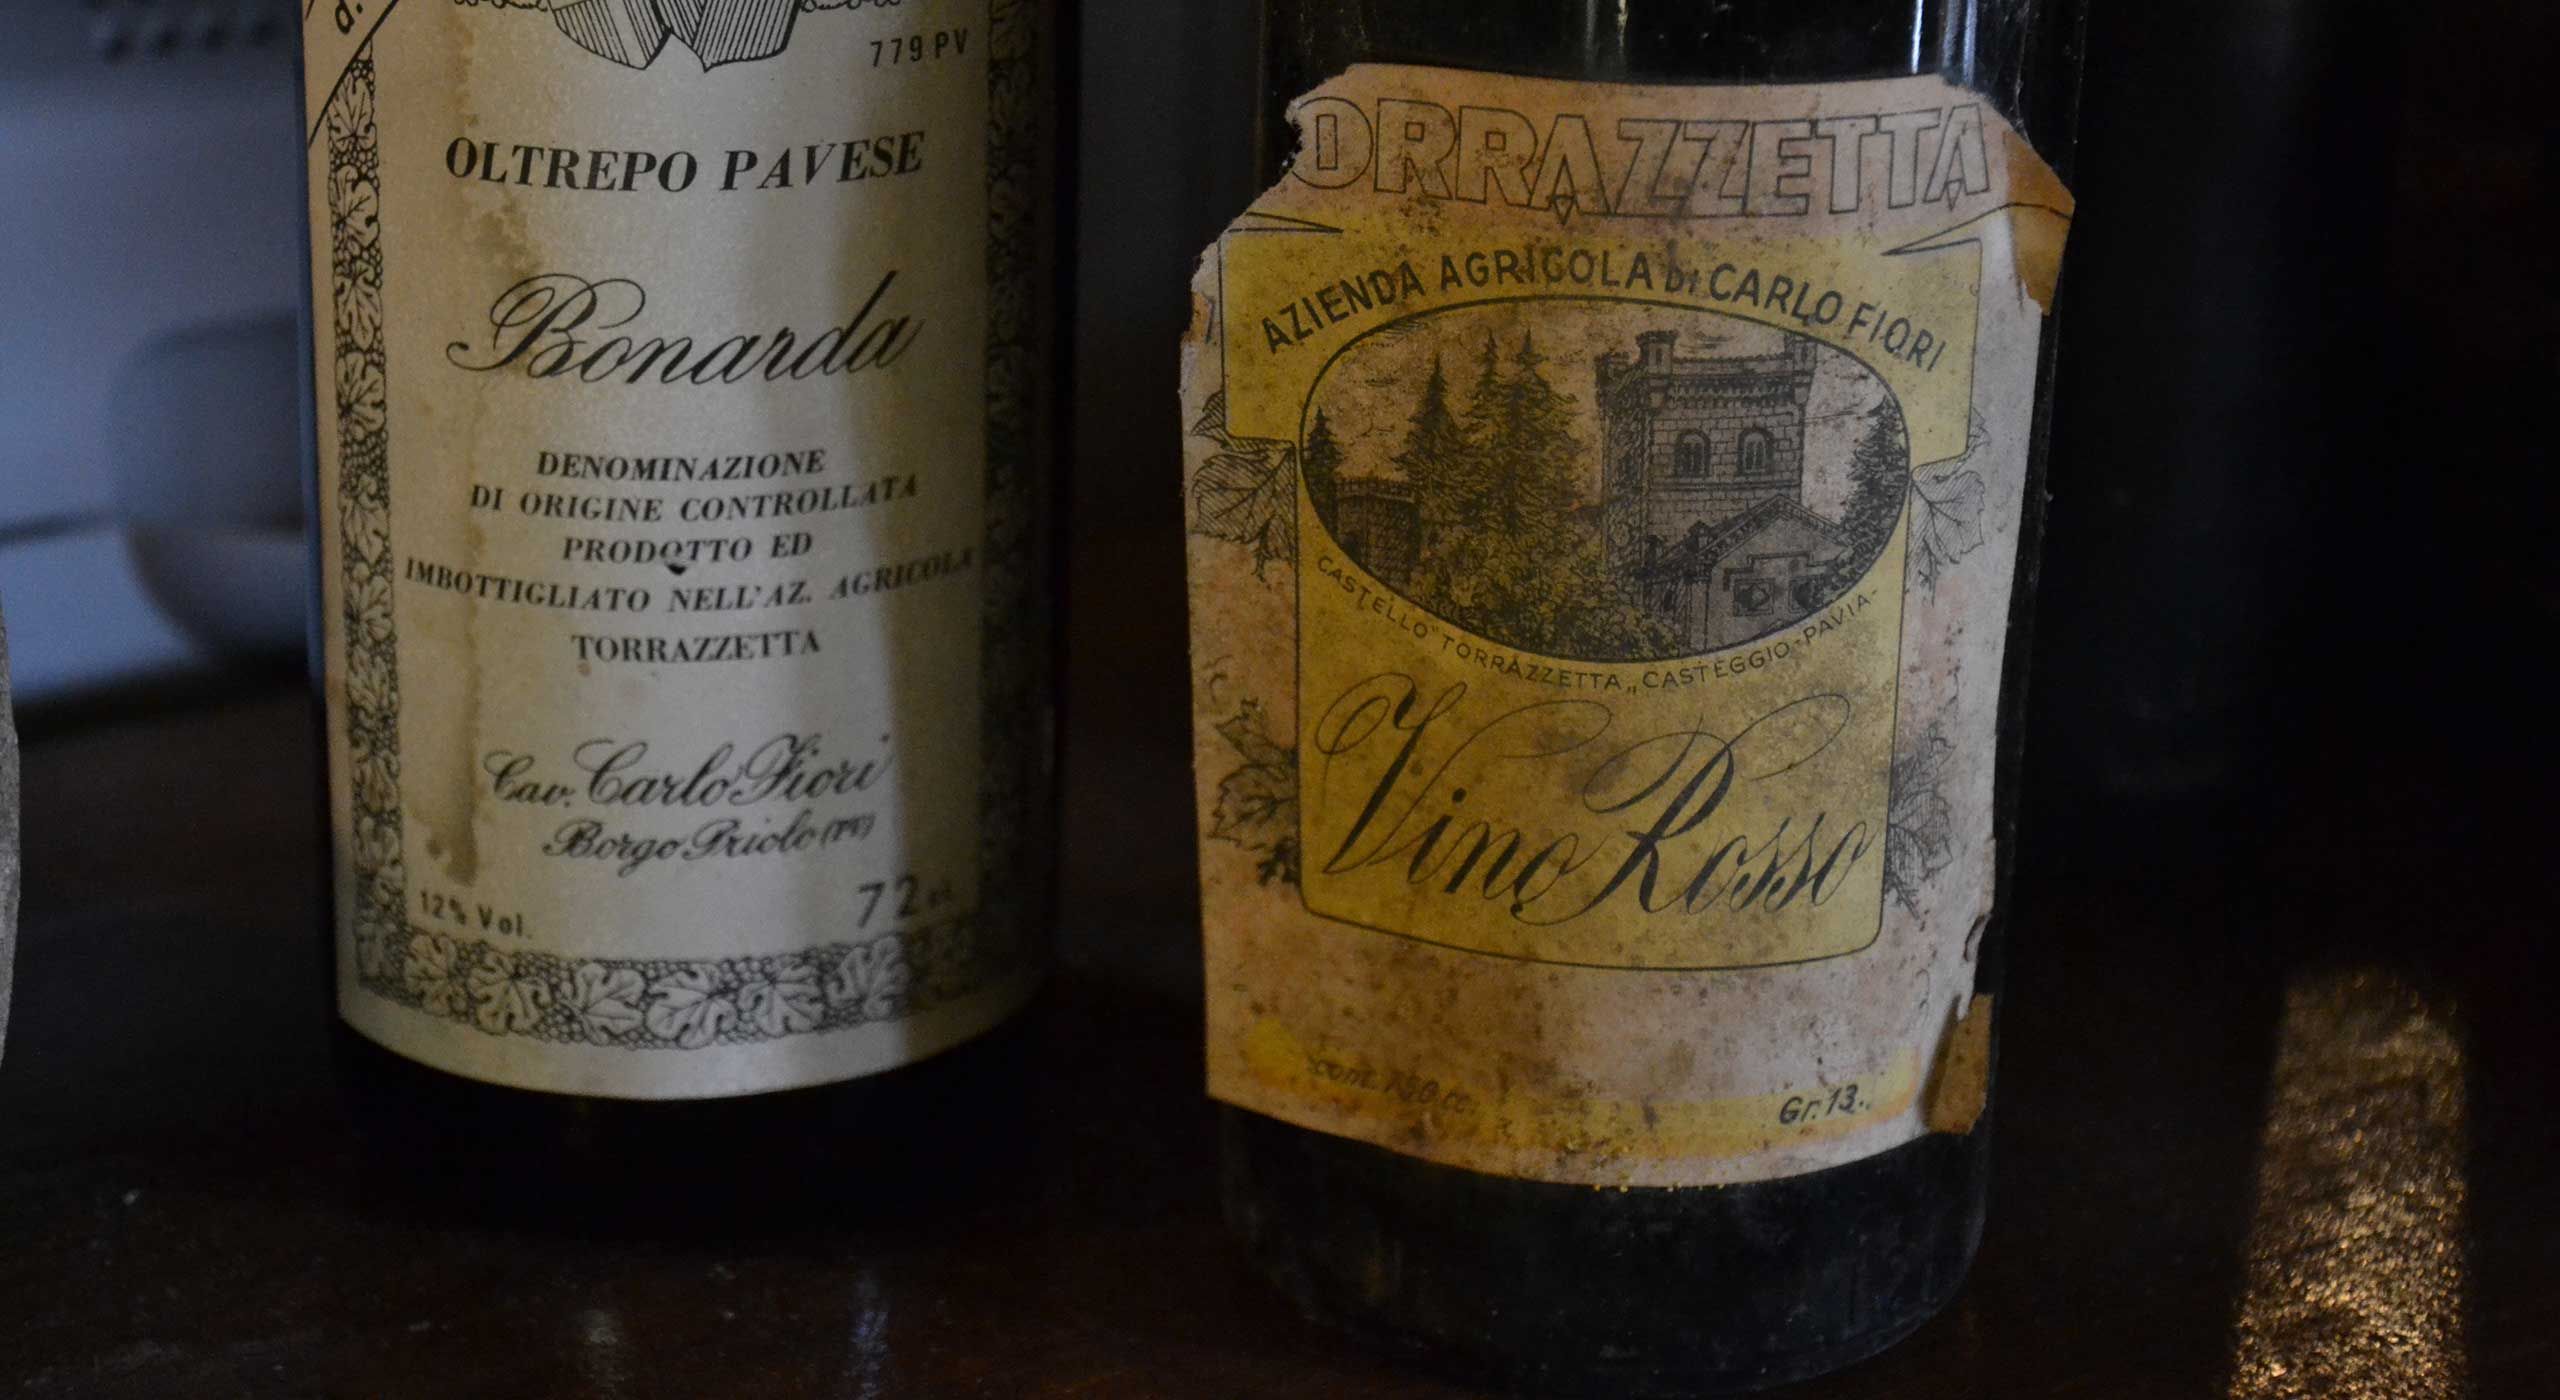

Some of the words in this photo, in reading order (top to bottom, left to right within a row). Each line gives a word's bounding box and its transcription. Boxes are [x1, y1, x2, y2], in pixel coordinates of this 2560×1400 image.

[870, 36, 923, 68] 779
[934, 28, 970, 59] PV
[445, 136, 697, 193] OLTREPO
[720, 131, 926, 191] PAVESE
[445, 270, 923, 386] Bonarda
[1261, 259, 1426, 354] AZIENDA
[1440, 246, 1654, 291] AGRICOLA
[1708, 262, 1844, 327] CARLO
[1848, 300, 1947, 373] FIORI
[536, 448, 827, 483] DENOMINAZIONE
[469, 483, 504, 511] DI
[519, 490, 662, 523] ORIGINE
[680, 472, 918, 522] CONTROLLATA
[562, 535, 752, 565] PRODOTTO
[770, 532, 813, 560] ED
[404, 557, 651, 613] IMBOTTIGLIATO
[828, 547, 977, 602] AGRICOLA
[1317, 555, 1428, 640] CASTELLO
[570, 629, 821, 663] TORRAZZETTA
[483, 750, 576, 806] Cav.
[573, 739, 735, 806] Carlo
[730, 733, 896, 806] Fiori
[1315, 673, 1612, 898] Vino
[1512, 693, 1882, 926] Rosso
[542, 816, 680, 878] Borgo
[682, 807, 814, 863] Priolo
[421, 889, 466, 925] 12%
[856, 874, 919, 929] 72
